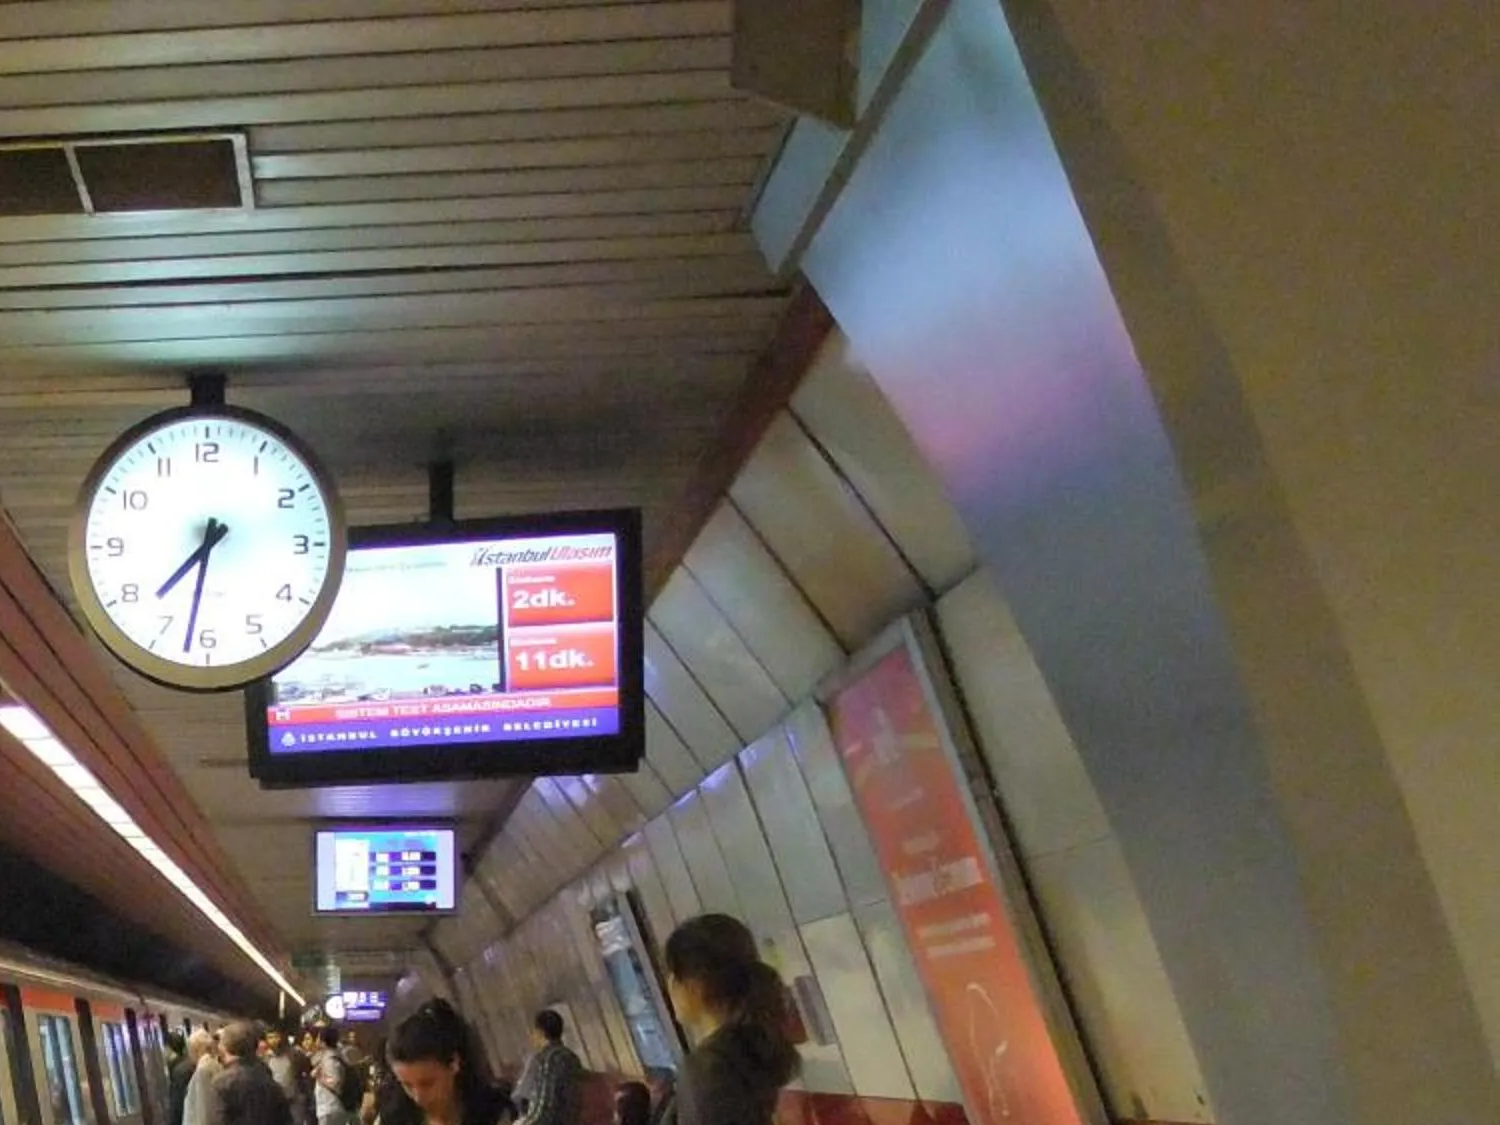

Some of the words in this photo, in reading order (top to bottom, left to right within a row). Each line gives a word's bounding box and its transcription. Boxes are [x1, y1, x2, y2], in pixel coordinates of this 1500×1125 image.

[195, 442, 220, 463] 12
[157, 457, 171, 477] 11
[123, 490, 148, 511] 10
[277, 488, 296, 509] 2
[106, 538, 125, 556] 9
[293, 535, 309, 554] 3
[121, 583, 139, 603] 8
[276, 584, 292, 602] 4
[512, 588, 576, 609] 2dk.
[158, 615, 174, 635] 7
[245, 614, 263, 635] 5
[199, 629, 217, 649] 6
[515, 650, 595, 671] 11dk.
